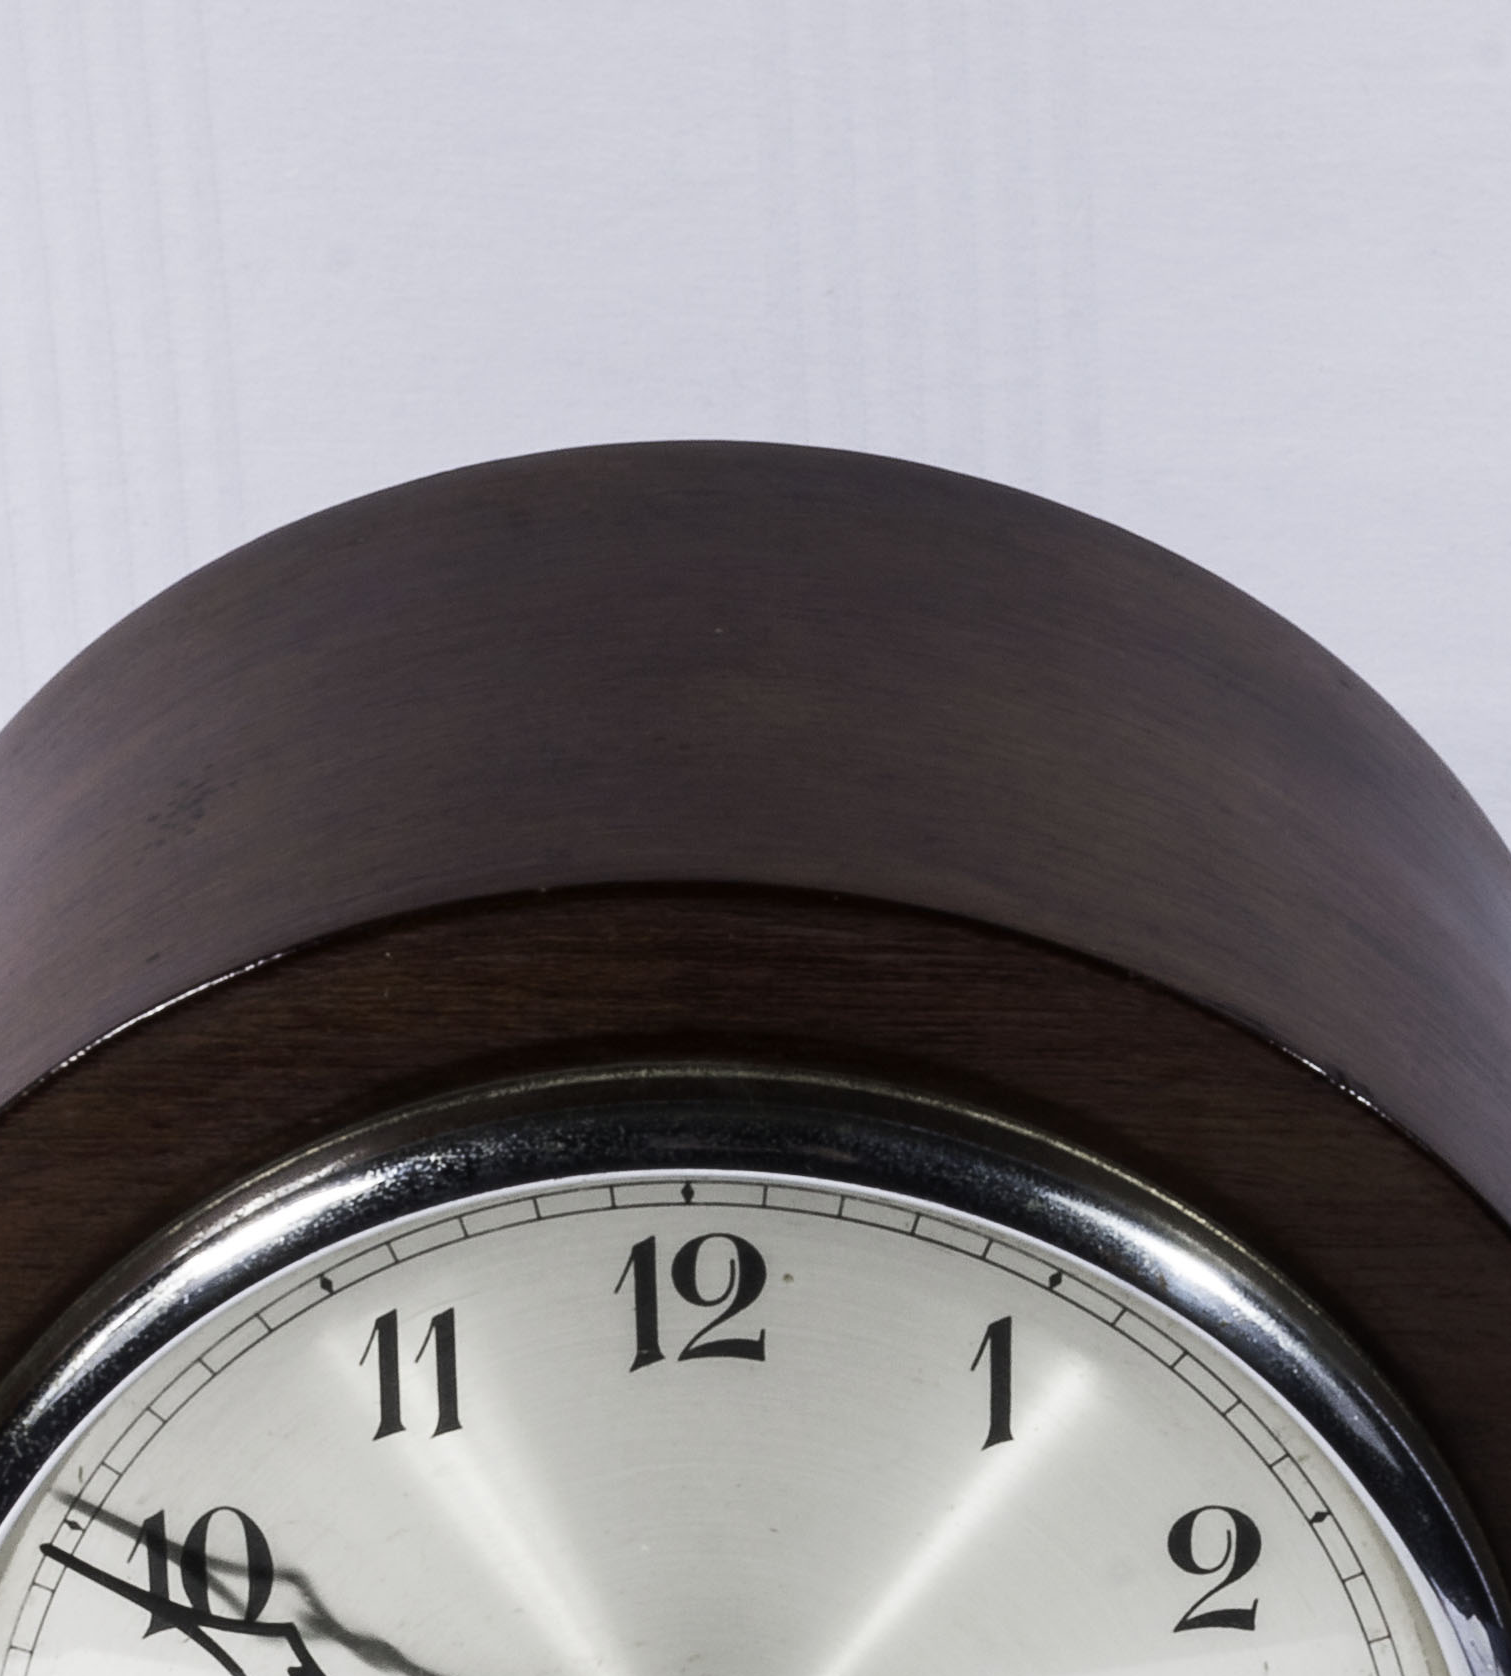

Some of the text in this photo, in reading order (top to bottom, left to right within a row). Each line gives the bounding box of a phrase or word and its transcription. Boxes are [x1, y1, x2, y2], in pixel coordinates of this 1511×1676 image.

[614, 1233, 766, 1374] 12
[359, 1307, 463, 1440] 11
[970, 1315, 1015, 1450] 1
[126, 1506, 274, 1638] 10
[1167, 1504, 1263, 1634] 2
